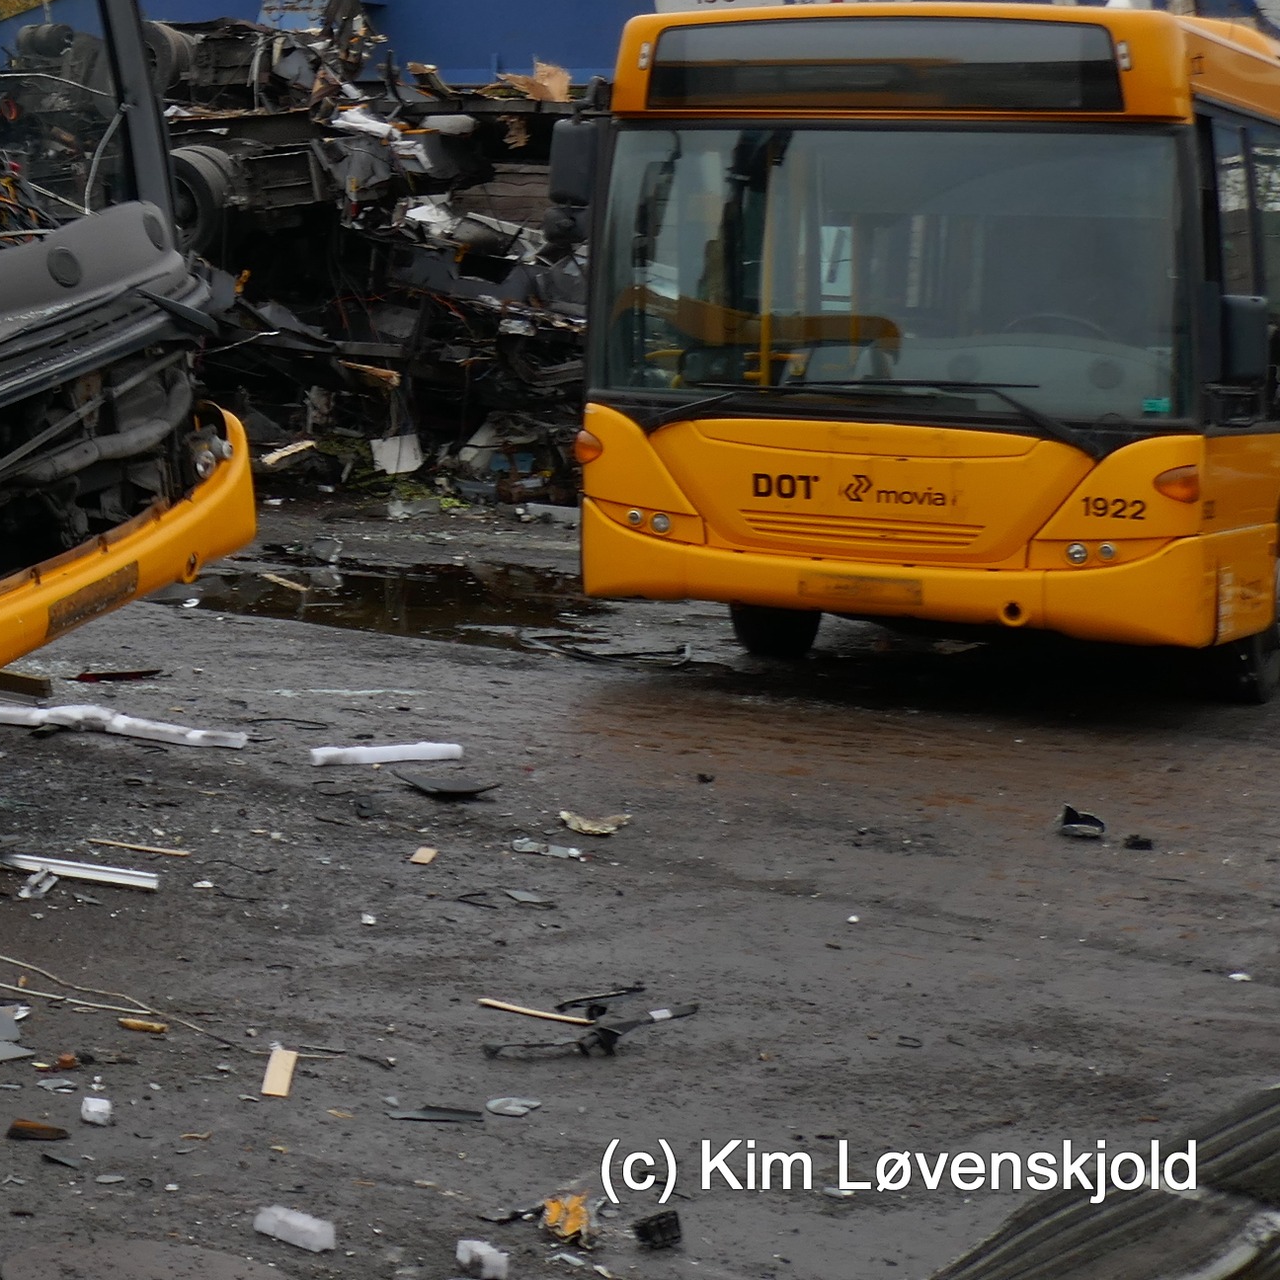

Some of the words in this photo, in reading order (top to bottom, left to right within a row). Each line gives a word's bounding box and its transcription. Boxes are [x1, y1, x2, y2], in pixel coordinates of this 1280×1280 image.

[752, 473, 820, 500] DOT
[876, 487, 947, 506] movia
[1082, 496, 1146, 520] 1922
